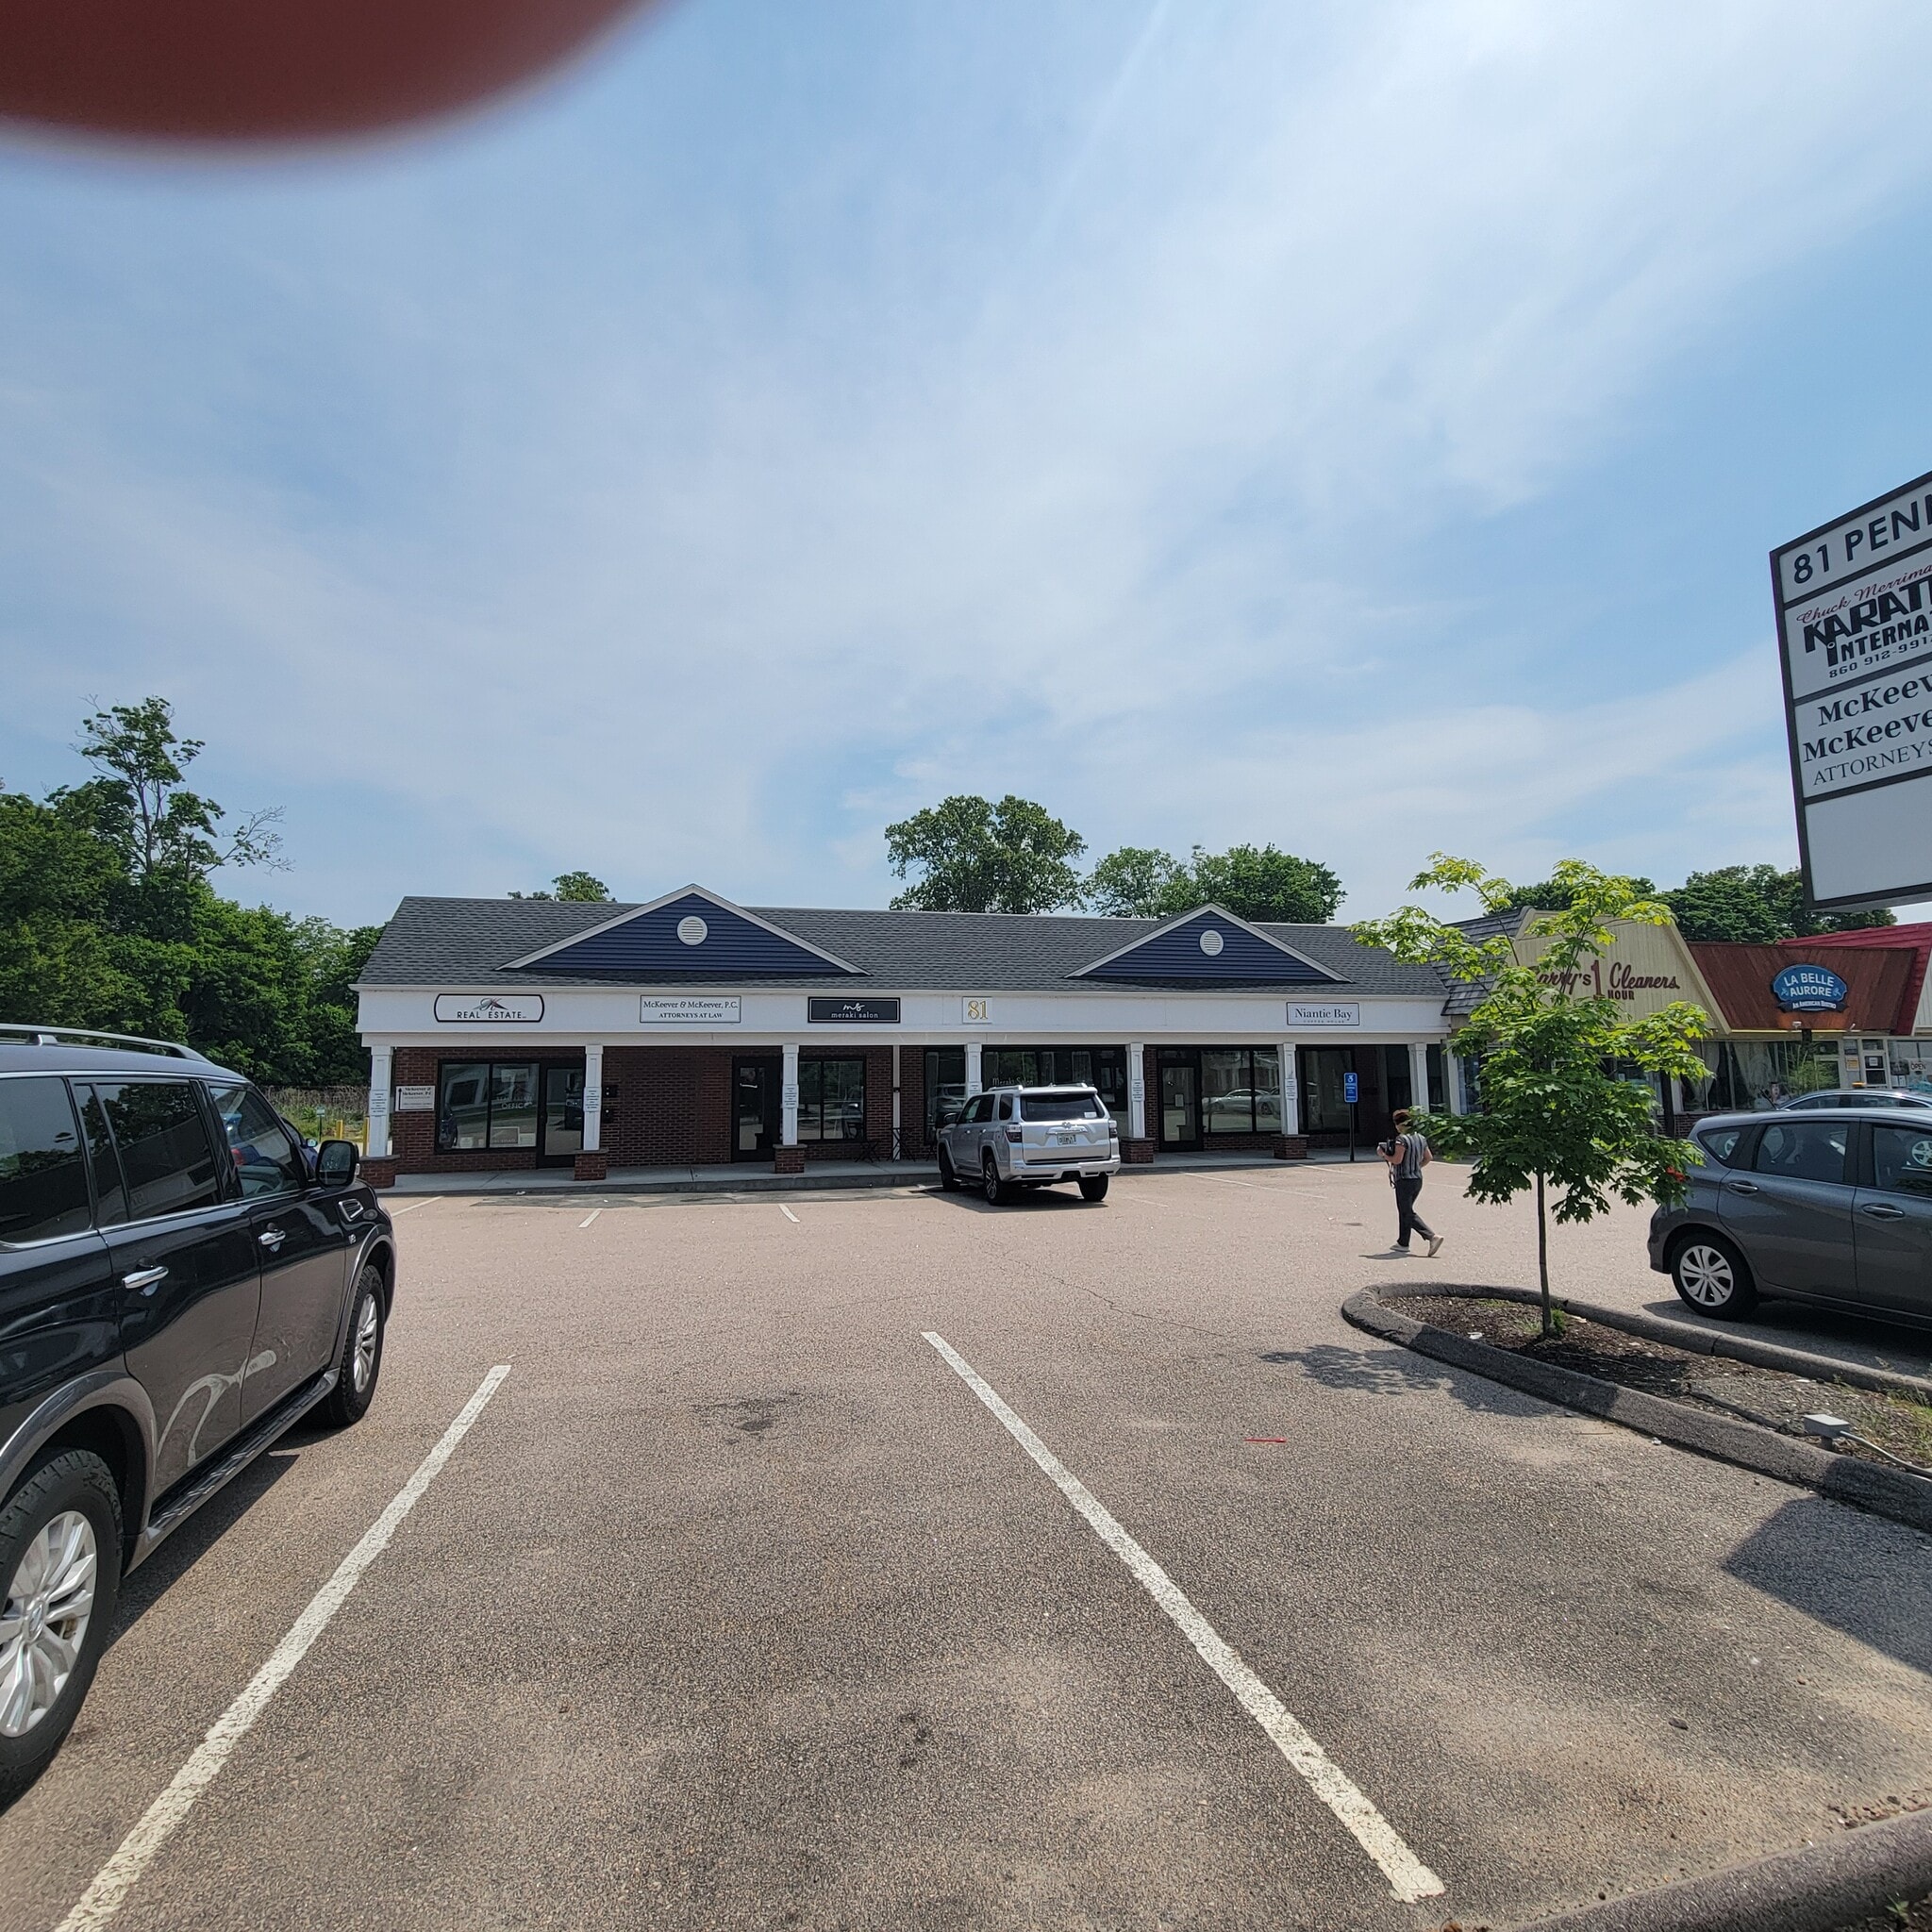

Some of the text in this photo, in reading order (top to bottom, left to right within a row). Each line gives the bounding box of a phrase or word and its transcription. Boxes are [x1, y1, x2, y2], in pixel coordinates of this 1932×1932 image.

[1793, 493, 1932, 584] 81 PEN
[1796, 596, 1851, 625] Chuck
[1803, 574, 1932, 653] KARAT
[1826, 609, 1932, 667] INTERNA
[1828, 662, 1857, 678] 860
[1784, 973, 1835, 987] LA BELLE
[1607, 990, 1635, 1000] HOUR
[1790, 986, 1832, 997] AURORE
[688, 1001, 724, 1009] McKeever,
[968, 1000, 989, 1020] 81
[1294, 1008, 1353, 1021] Niantic Bay
